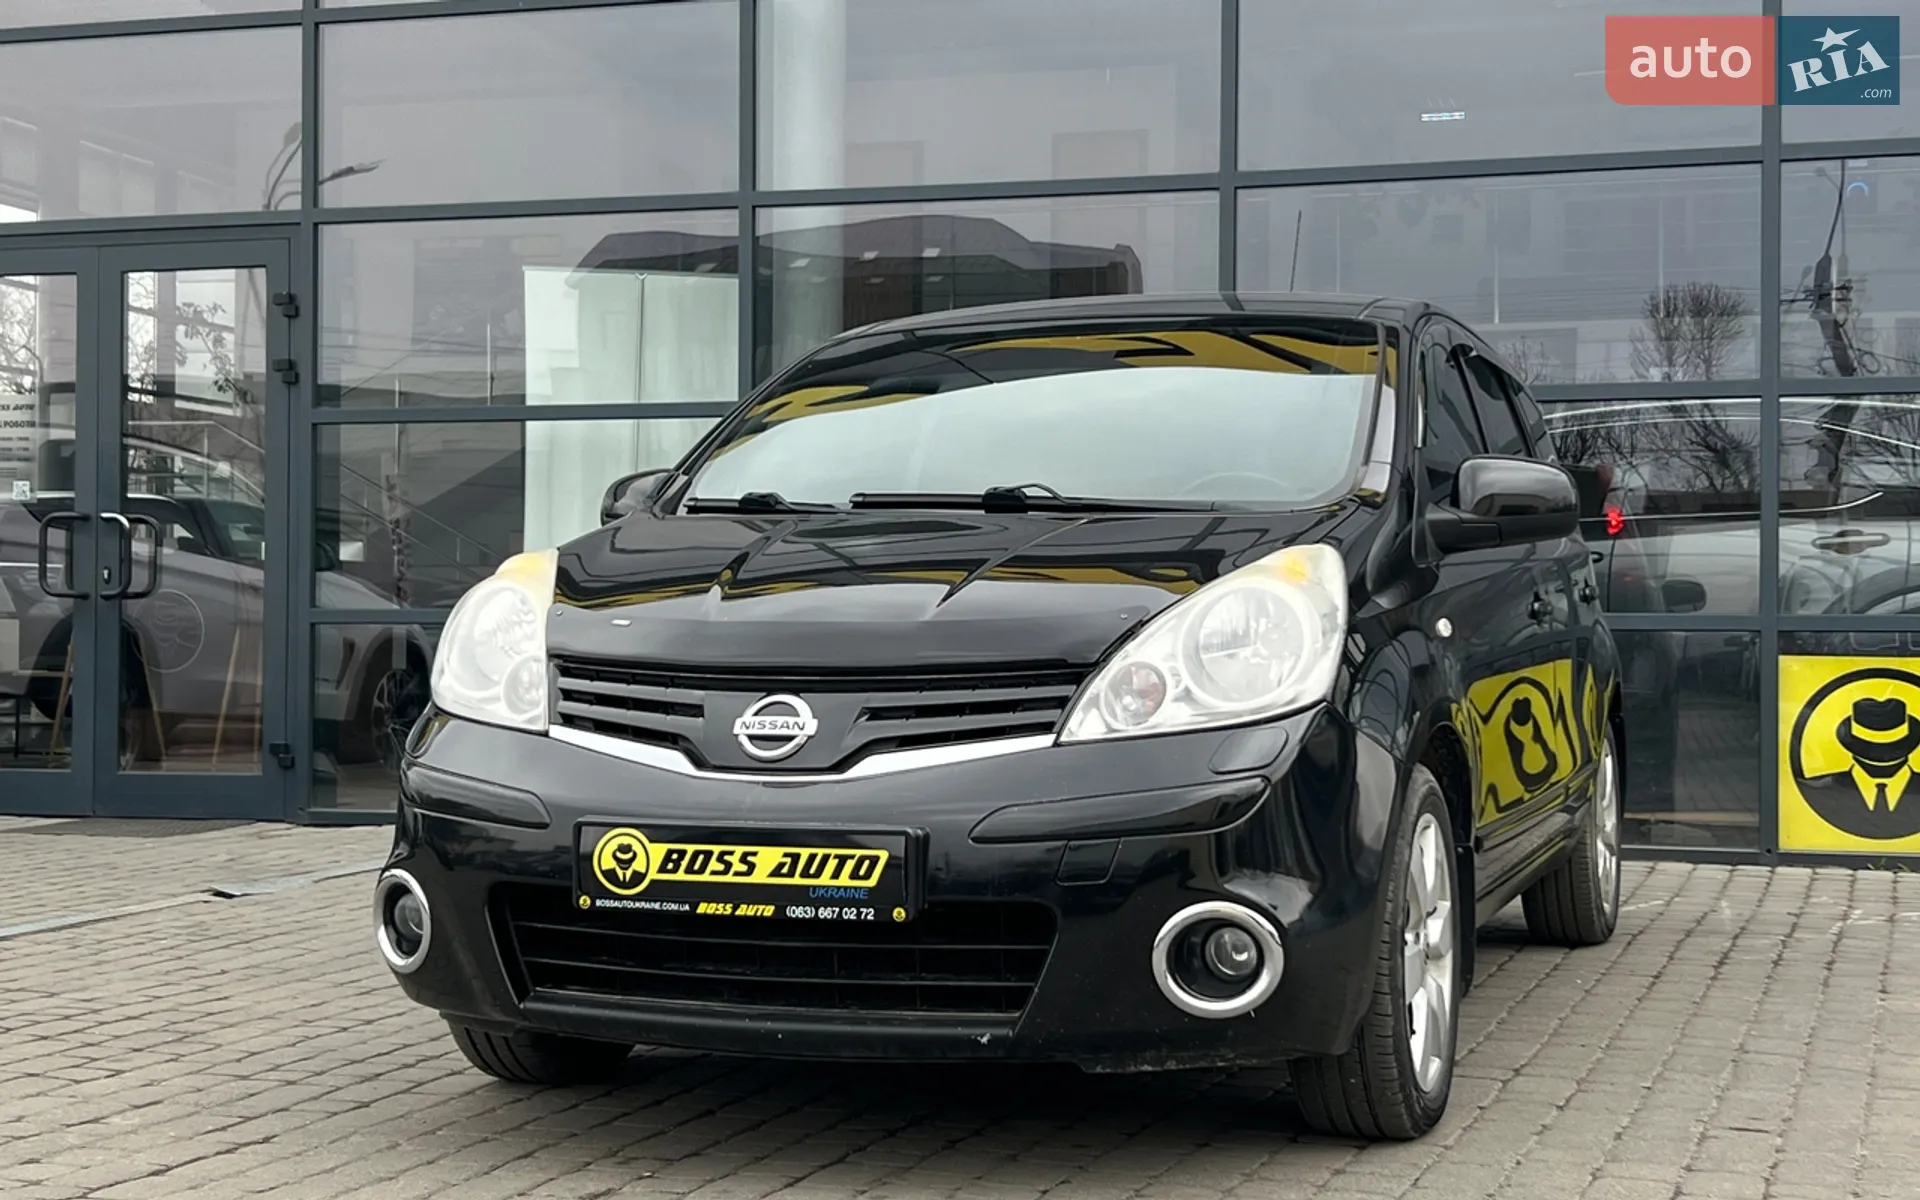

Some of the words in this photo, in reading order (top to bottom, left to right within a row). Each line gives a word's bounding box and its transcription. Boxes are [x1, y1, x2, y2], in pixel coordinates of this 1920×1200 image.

[740, 720, 806, 731] NISSAN
[656, 849, 759, 877] BOSS
[766, 852, 881, 880] AUTO
[809, 887, 869, 900] UKRAINE
[696, 902, 733, 914] BOSS
[734, 905, 775, 917] AUTO
[786, 906, 815, 919] (063)
[817, 908, 839, 919] 667
[842, 908, 857, 920] 02
[859, 908, 875, 920] 72
